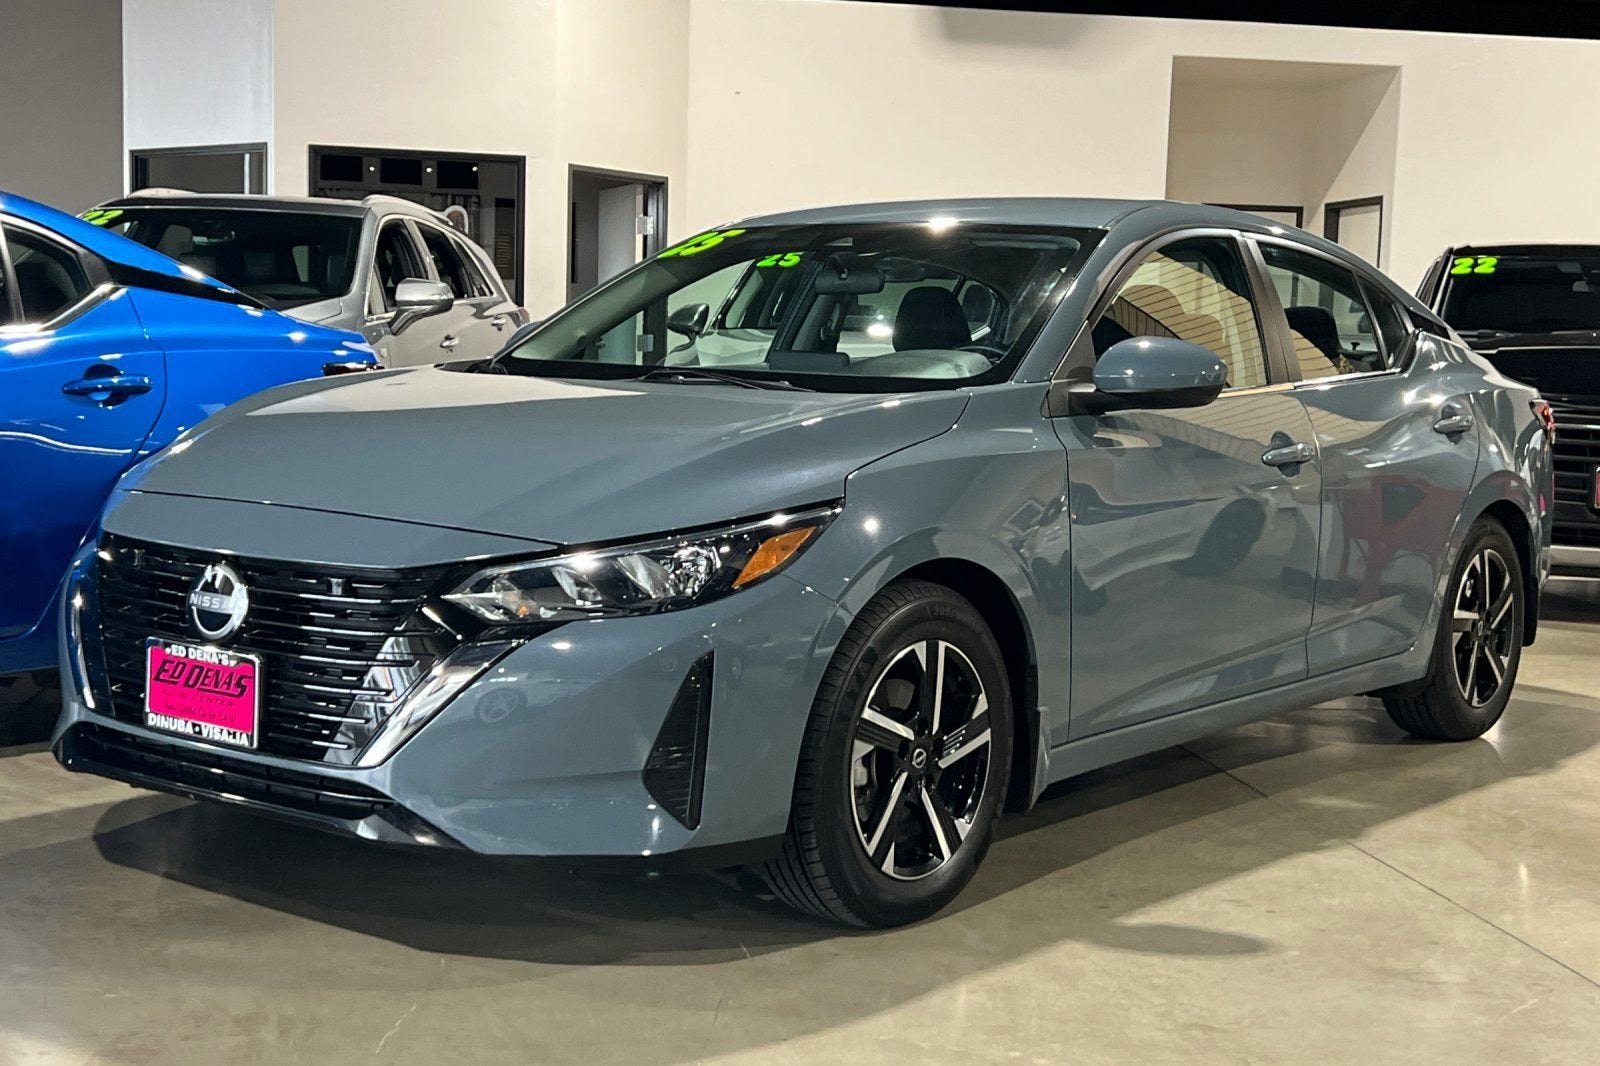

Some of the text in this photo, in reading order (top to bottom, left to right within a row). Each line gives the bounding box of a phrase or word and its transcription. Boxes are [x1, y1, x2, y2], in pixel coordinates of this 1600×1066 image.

[756, 251, 805, 268] 25
[1450, 257, 1498, 275] 22
[189, 592, 245, 613] NISS
[171, 644, 187, 658] ED
[154, 658, 187, 685] ED
[147, 713, 250, 746] DINUBA VISALIA
